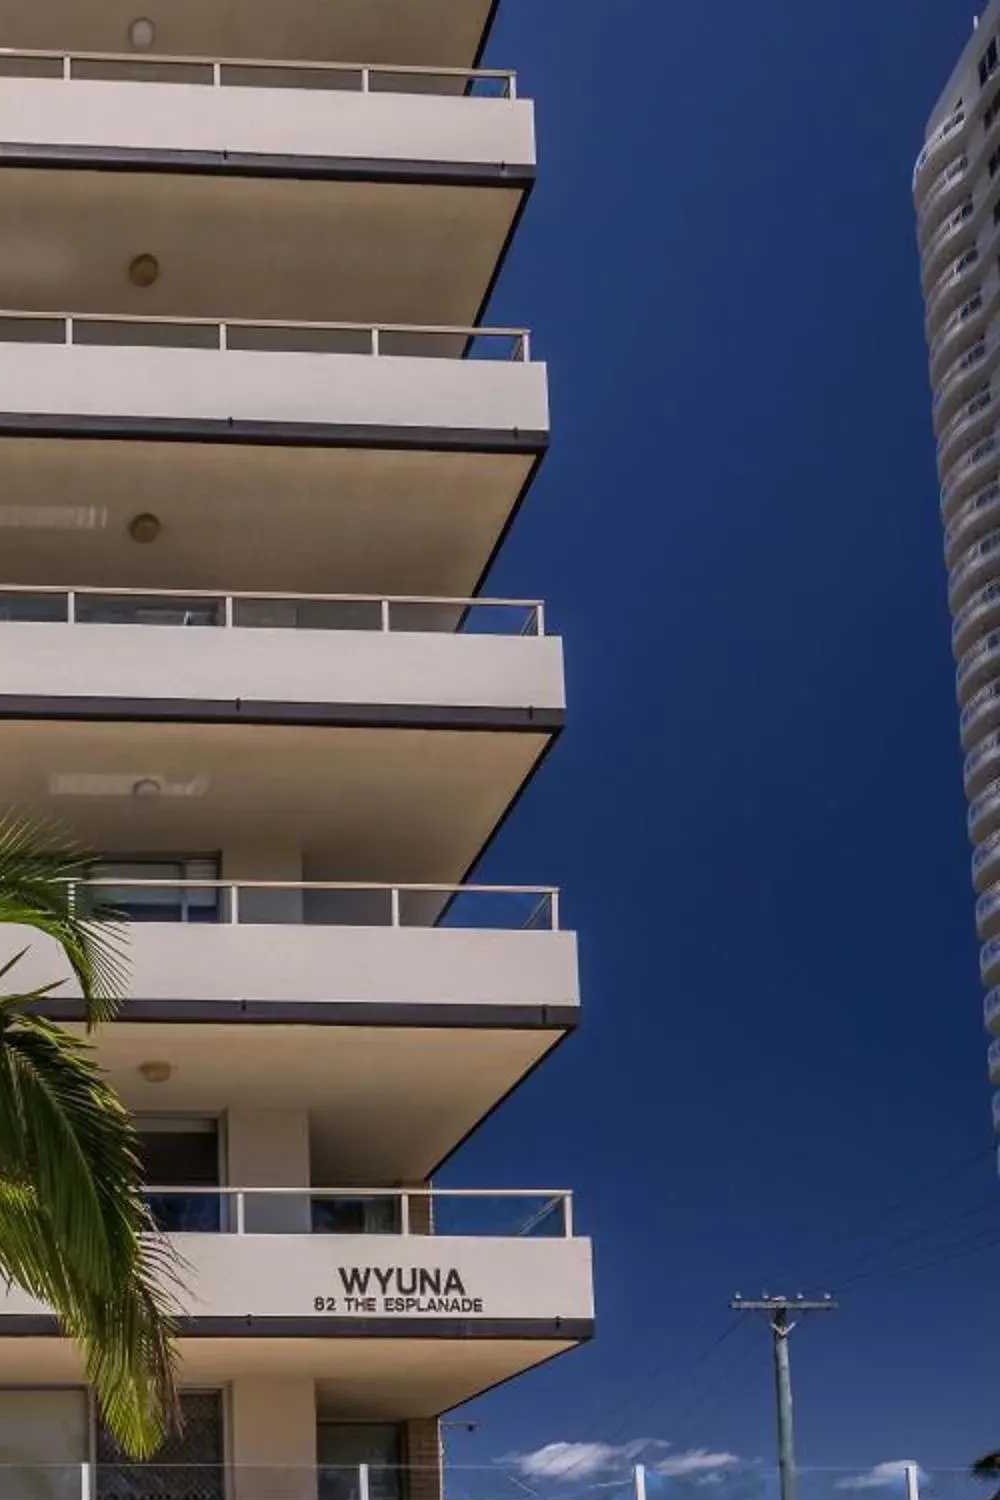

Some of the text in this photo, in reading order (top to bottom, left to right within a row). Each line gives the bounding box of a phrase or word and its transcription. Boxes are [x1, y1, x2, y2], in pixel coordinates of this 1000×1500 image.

[338, 1267, 466, 1296] WYUNA
[314, 1297, 483, 1312] 82 THE ESPLANADE
